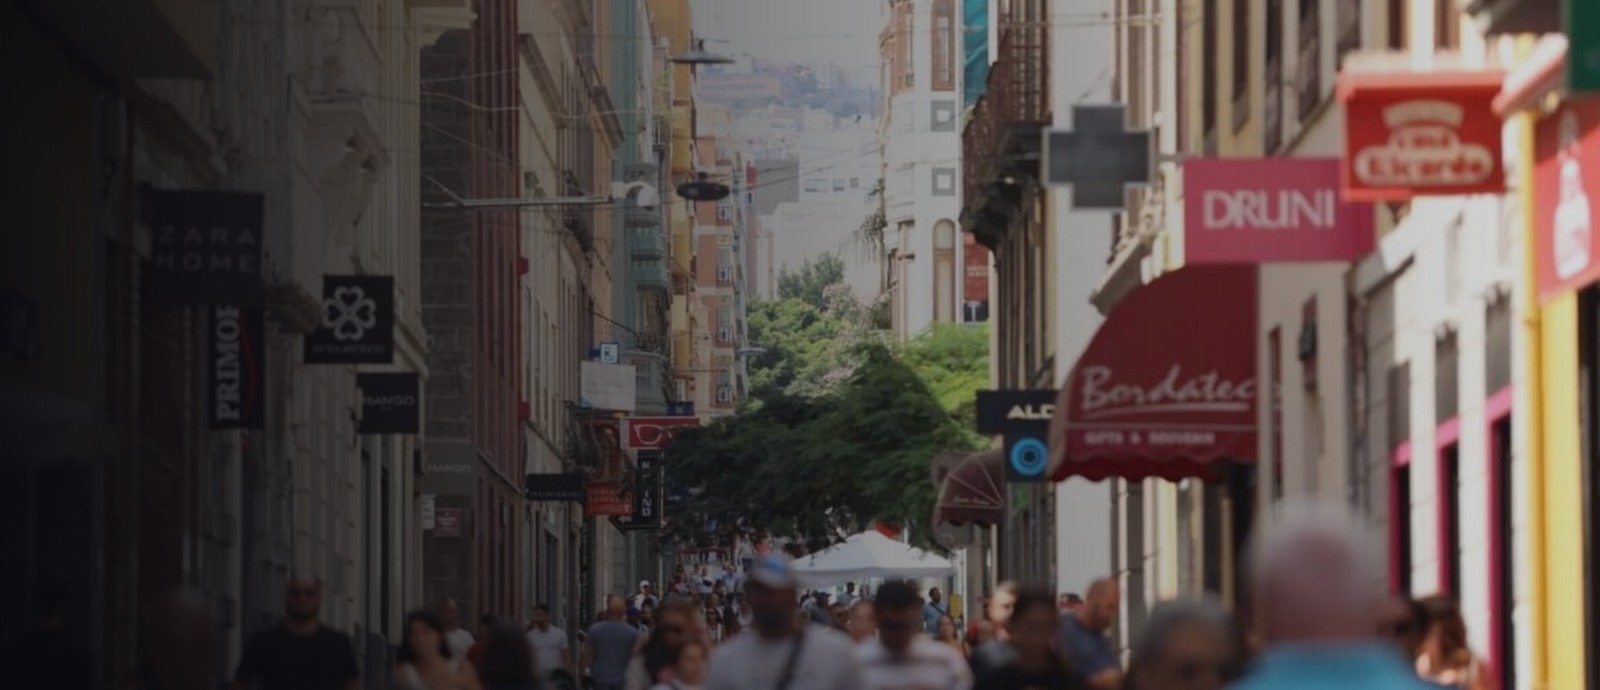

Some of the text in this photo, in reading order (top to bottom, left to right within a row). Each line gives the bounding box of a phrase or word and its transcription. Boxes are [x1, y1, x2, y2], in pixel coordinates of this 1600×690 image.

[1203, 189, 1335, 228] DRUNI
[159, 225, 255, 245] ZARA
[157, 252, 255, 273] HOME
